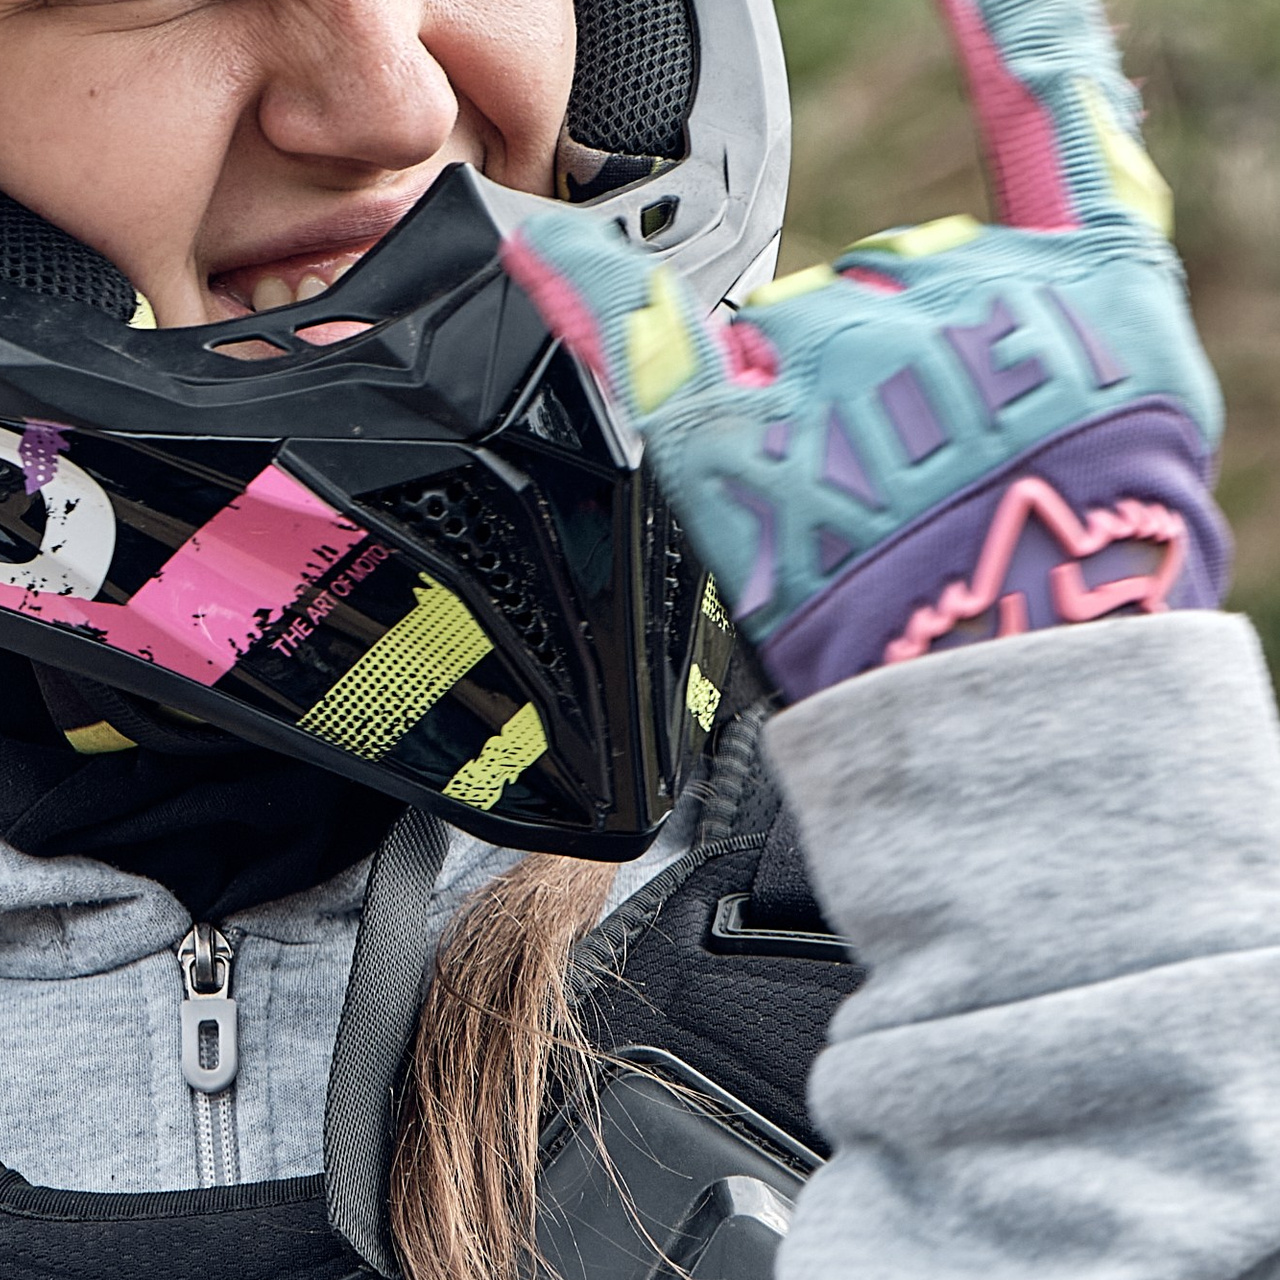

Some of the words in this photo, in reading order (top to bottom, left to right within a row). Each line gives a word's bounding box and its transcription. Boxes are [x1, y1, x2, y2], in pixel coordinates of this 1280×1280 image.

[272, 617, 314, 657] THE
[305, 589, 338, 625] ART
[330, 573, 355, 597] OF
[346, 544, 389, 582] MOTO
